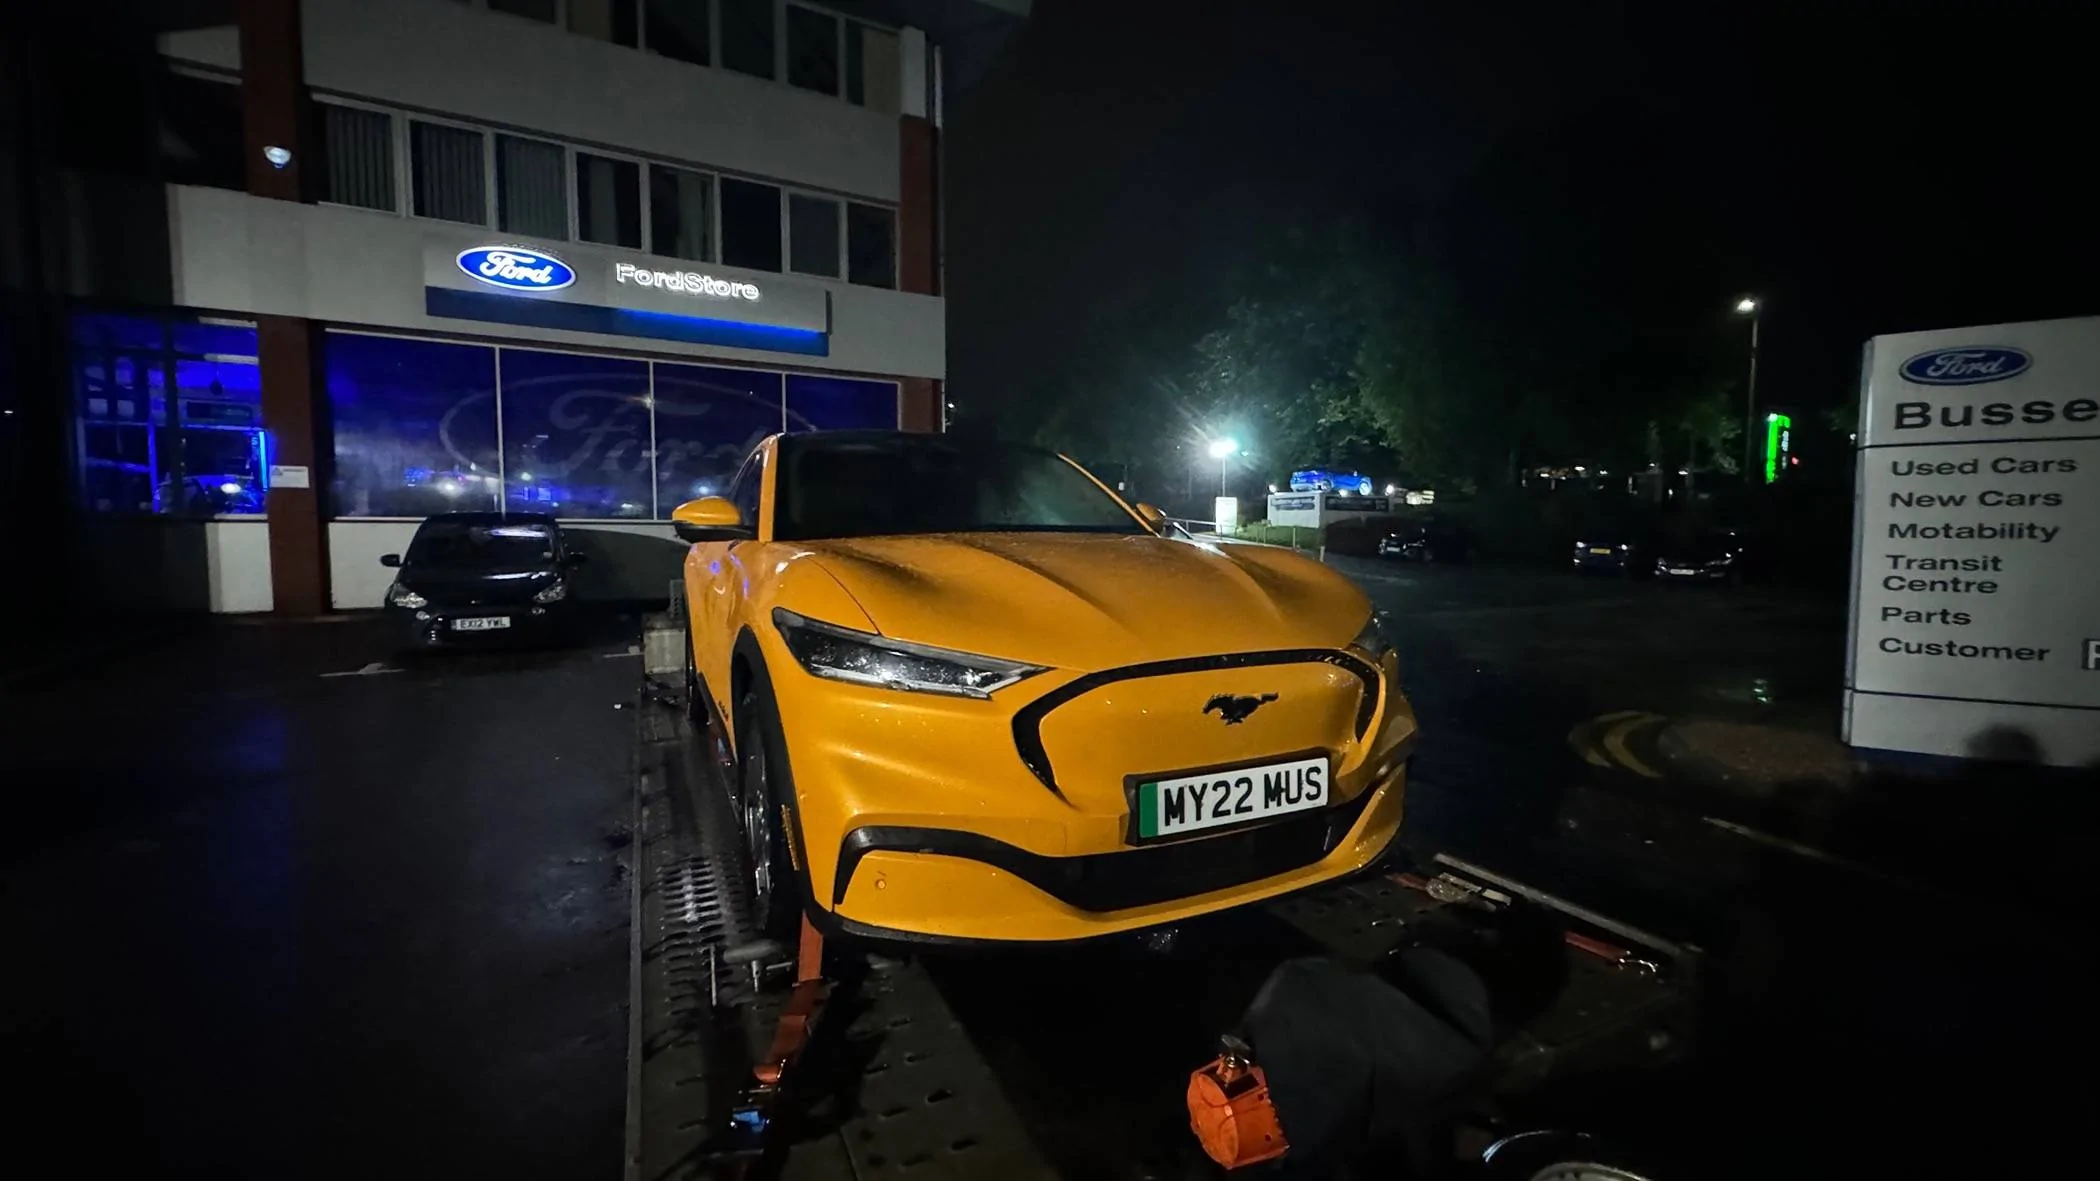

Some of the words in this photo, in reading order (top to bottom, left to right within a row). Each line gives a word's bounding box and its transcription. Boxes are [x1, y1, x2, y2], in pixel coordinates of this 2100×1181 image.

[479, 251, 552, 285] Ford
[615, 262, 760, 300] FordStore
[1926, 351, 2006, 377] Ford
[1891, 458, 1979, 476] Used
[1990, 456, 2078, 474] Cars
[1890, 491, 1966, 508] New
[1978, 489, 2063, 507] Cars
[1888, 522, 2060, 543] Motability
[1886, 555, 2002, 572] Transit
[1882, 576, 1998, 594] Centre
[1881, 607, 1972, 626] Parts
[1879, 637, 2050, 661] Customer
[1164, 777, 1253, 826] MY22
[1264, 766, 1322, 809] MUS
